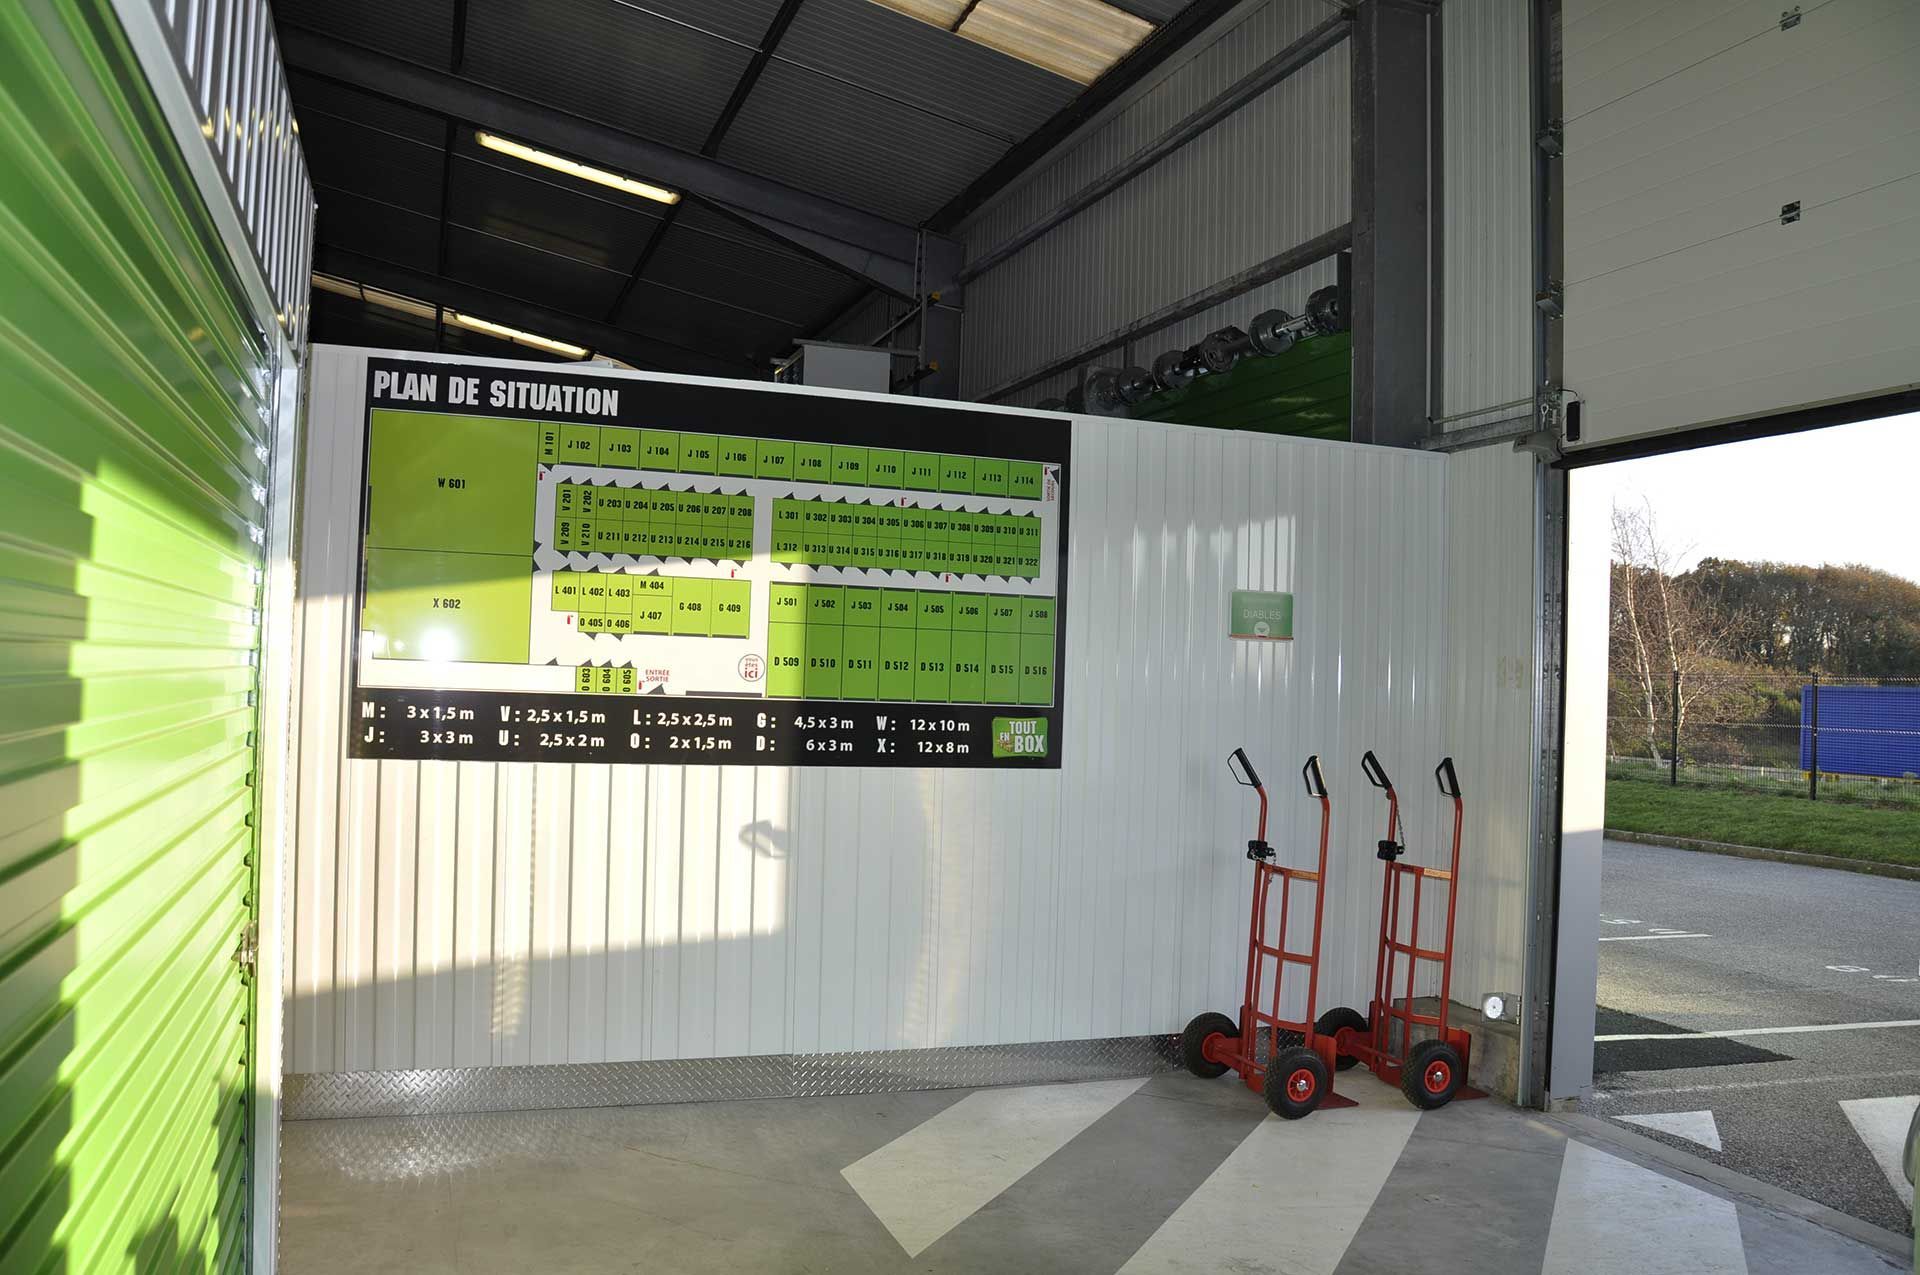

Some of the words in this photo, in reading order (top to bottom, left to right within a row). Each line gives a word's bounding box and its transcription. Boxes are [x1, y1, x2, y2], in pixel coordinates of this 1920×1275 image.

[373, 370, 437, 403] PLAN
[448, 376, 479, 406] DE
[490, 380, 619, 417] SITUATION
[545, 432, 554, 445] 101
[576, 441, 590, 450] 102
[617, 444, 631, 453] 103
[655, 447, 669, 456] 104
[696, 450, 709, 459] 105
[733, 453, 747, 462] 106
[771, 456, 784, 464] 107
[809, 459, 822, 467] 108
[846, 462, 859, 470] 109
[883, 465, 896, 474] 110
[919, 468, 931, 476] 111
[954, 471, 966, 479] 112
[989, 474, 1002, 482] 113
[449, 478, 465, 489] 601
[1021, 476, 1034, 485] 114
[562, 489, 571, 503] 201
[583, 490, 592, 505] 202
[607, 499, 622, 508] 203
[633, 501, 648, 510] 204
[660, 502, 674, 511] 205
[686, 504, 701, 513] 206
[785, 511, 798, 520] 301
[813, 513, 830, 522] 302
[649, 581, 664, 590] 404
[562, 586, 576, 595] 401
[589, 587, 604, 596] 402
[615, 589, 630, 597] 403
[443, 598, 461, 609] 602
[784, 597, 797, 606] 501
[821, 599, 835, 608] 502
[687, 603, 701, 611] 408
[726, 604, 741, 612] 409
[647, 611, 662, 620] 407
[1243, 608, 1281, 620] DIABLES
[588, 618, 603, 627] 405
[615, 619, 630, 628] 406
[783, 657, 799, 667] 509
[819, 658, 836, 668] 510
[857, 660, 871, 669] 511
[893, 661, 909, 671] 512
[929, 662, 944, 672] 513
[964, 664, 979, 673] 514
[582, 668, 591, 683] 603
[602, 669, 611, 684] 604
[645, 668, 670, 676] ENTRÉE
[745, 667, 758, 678] ici
[623, 670, 631, 684] 605
[407, 706, 416, 718] 3
[420, 709, 429, 718] x
[433, 706, 456, 721] 1,5
[460, 710, 474, 720] m
[527, 709, 550, 724] 2,5
[554, 712, 562, 722] x
[566, 710, 588, 725] 1,5
[592, 714, 605, 723] m
[658, 712, 679, 727] 2,5
[682, 716, 691, 725] x
[694, 714, 715, 727] 2,5
[719, 717, 732, 726] m
[794, 716, 815, 730] 4,5
[818, 720, 826, 728] x
[830, 717, 837, 728] 3
[841, 720, 853, 729] m
[910, 719, 925, 730] 12
[928, 722, 936, 730] x
[940, 720, 955, 731] 10
[958, 723, 969, 731] m
[1009, 720, 1037, 734] TOUT
[420, 730, 429, 743] 3
[433, 734, 442, 743] x
[446, 731, 454, 743] 3
[459, 734, 473, 744] m
[540, 733, 562, 748] 2,5
[566, 737, 575, 746] x
[578, 734, 587, 747] 2
[591, 737, 604, 747] m
[1000, 732, 1010, 742] EN
[670, 736, 678, 748] 2
[682, 739, 690, 748] x
[694, 737, 714, 750] 1,5
[718, 740, 731, 749] m
[806, 739, 814, 750] 6
[818, 742, 825, 751] x
[829, 740, 836, 751] 3
[840, 742, 852, 751] m
[918, 742, 932, 752] 12
[936, 744, 943, 753] x
[946, 742, 954, 753] 8
[957, 745, 969, 753] m
[1014, 735, 1045, 753] BOX
